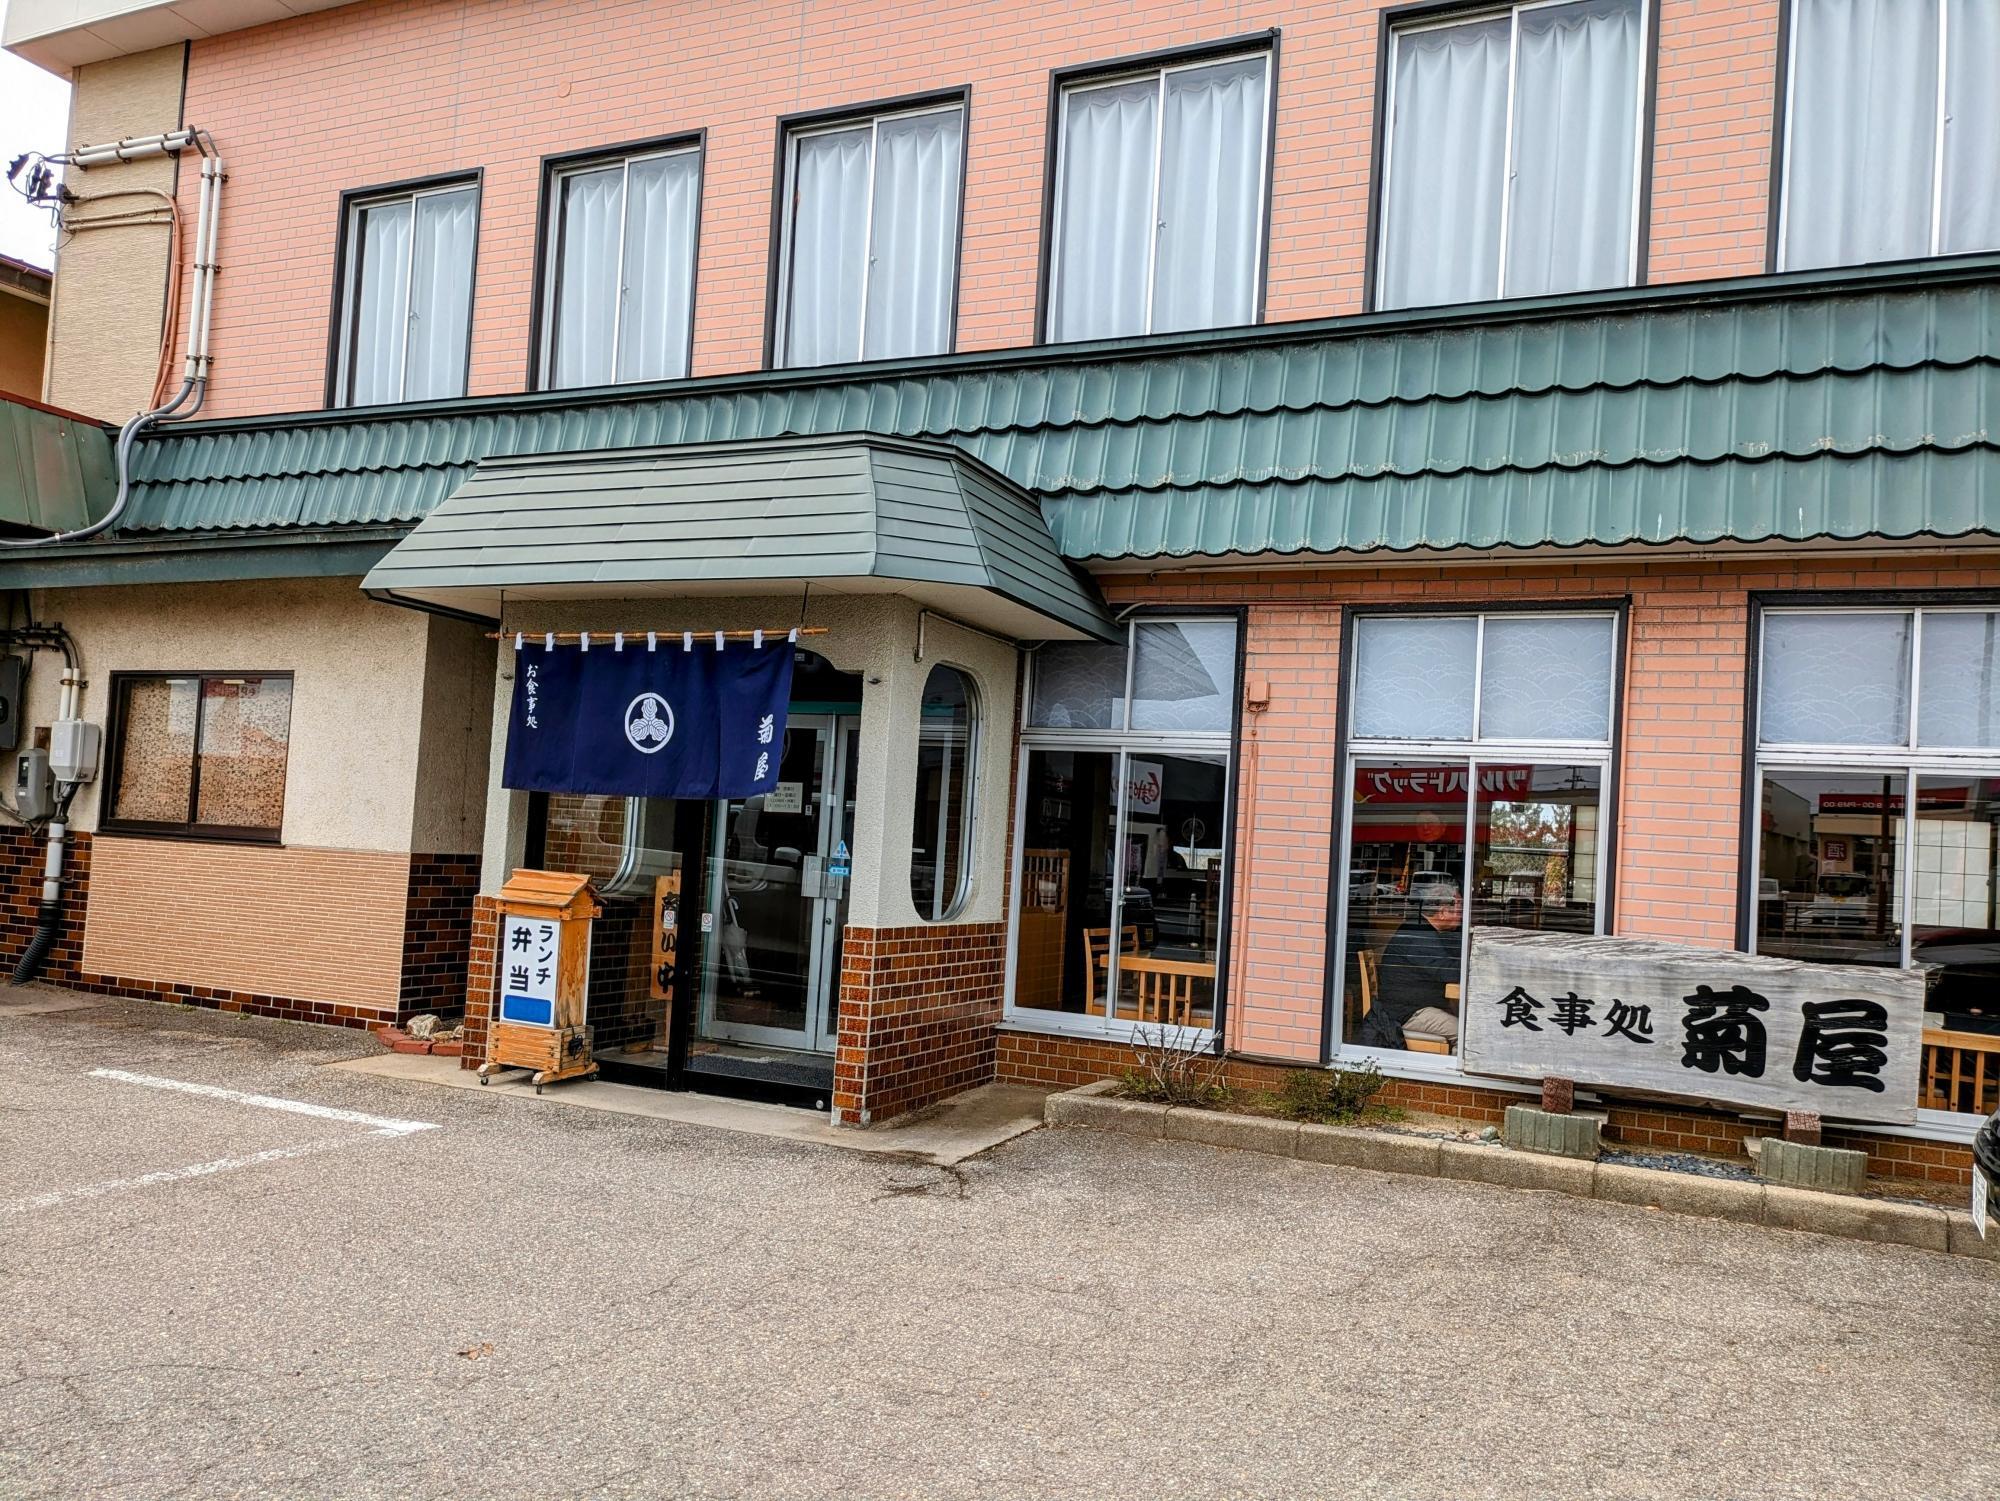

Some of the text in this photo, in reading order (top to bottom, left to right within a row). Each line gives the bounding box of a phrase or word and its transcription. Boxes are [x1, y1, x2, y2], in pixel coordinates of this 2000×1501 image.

[525, 663, 539, 729] お食事処
[753, 713, 774, 782] 菊屋
[509, 926, 532, 992] 弁当
[536, 924, 553, 985] ランチ
[1496, 984, 1889, 1093] 食事処 菊屋
